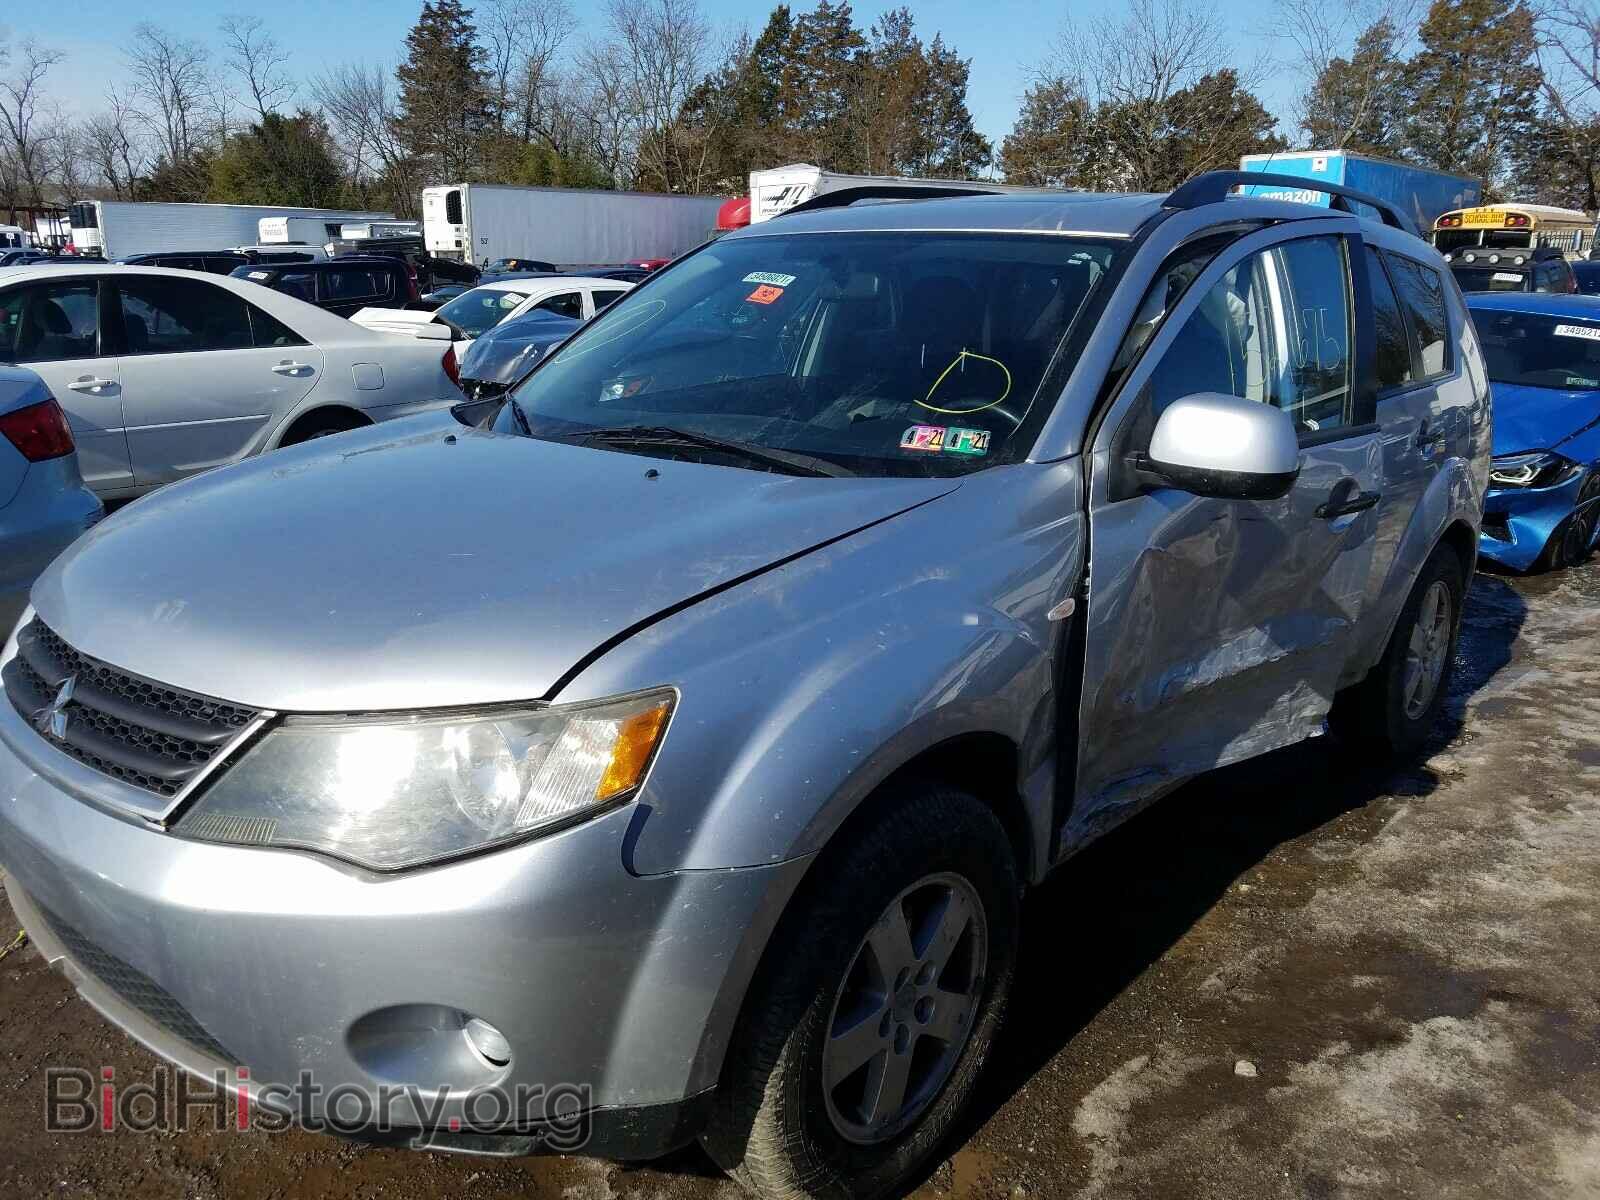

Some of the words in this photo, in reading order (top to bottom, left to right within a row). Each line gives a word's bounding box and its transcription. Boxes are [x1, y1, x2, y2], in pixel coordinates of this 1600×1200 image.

[1464, 214, 1489, 224] SCHOOL
[1491, 213, 1505, 223] BUS
[929, 429, 944, 446] 21
[973, 432, 987, 450] 21
